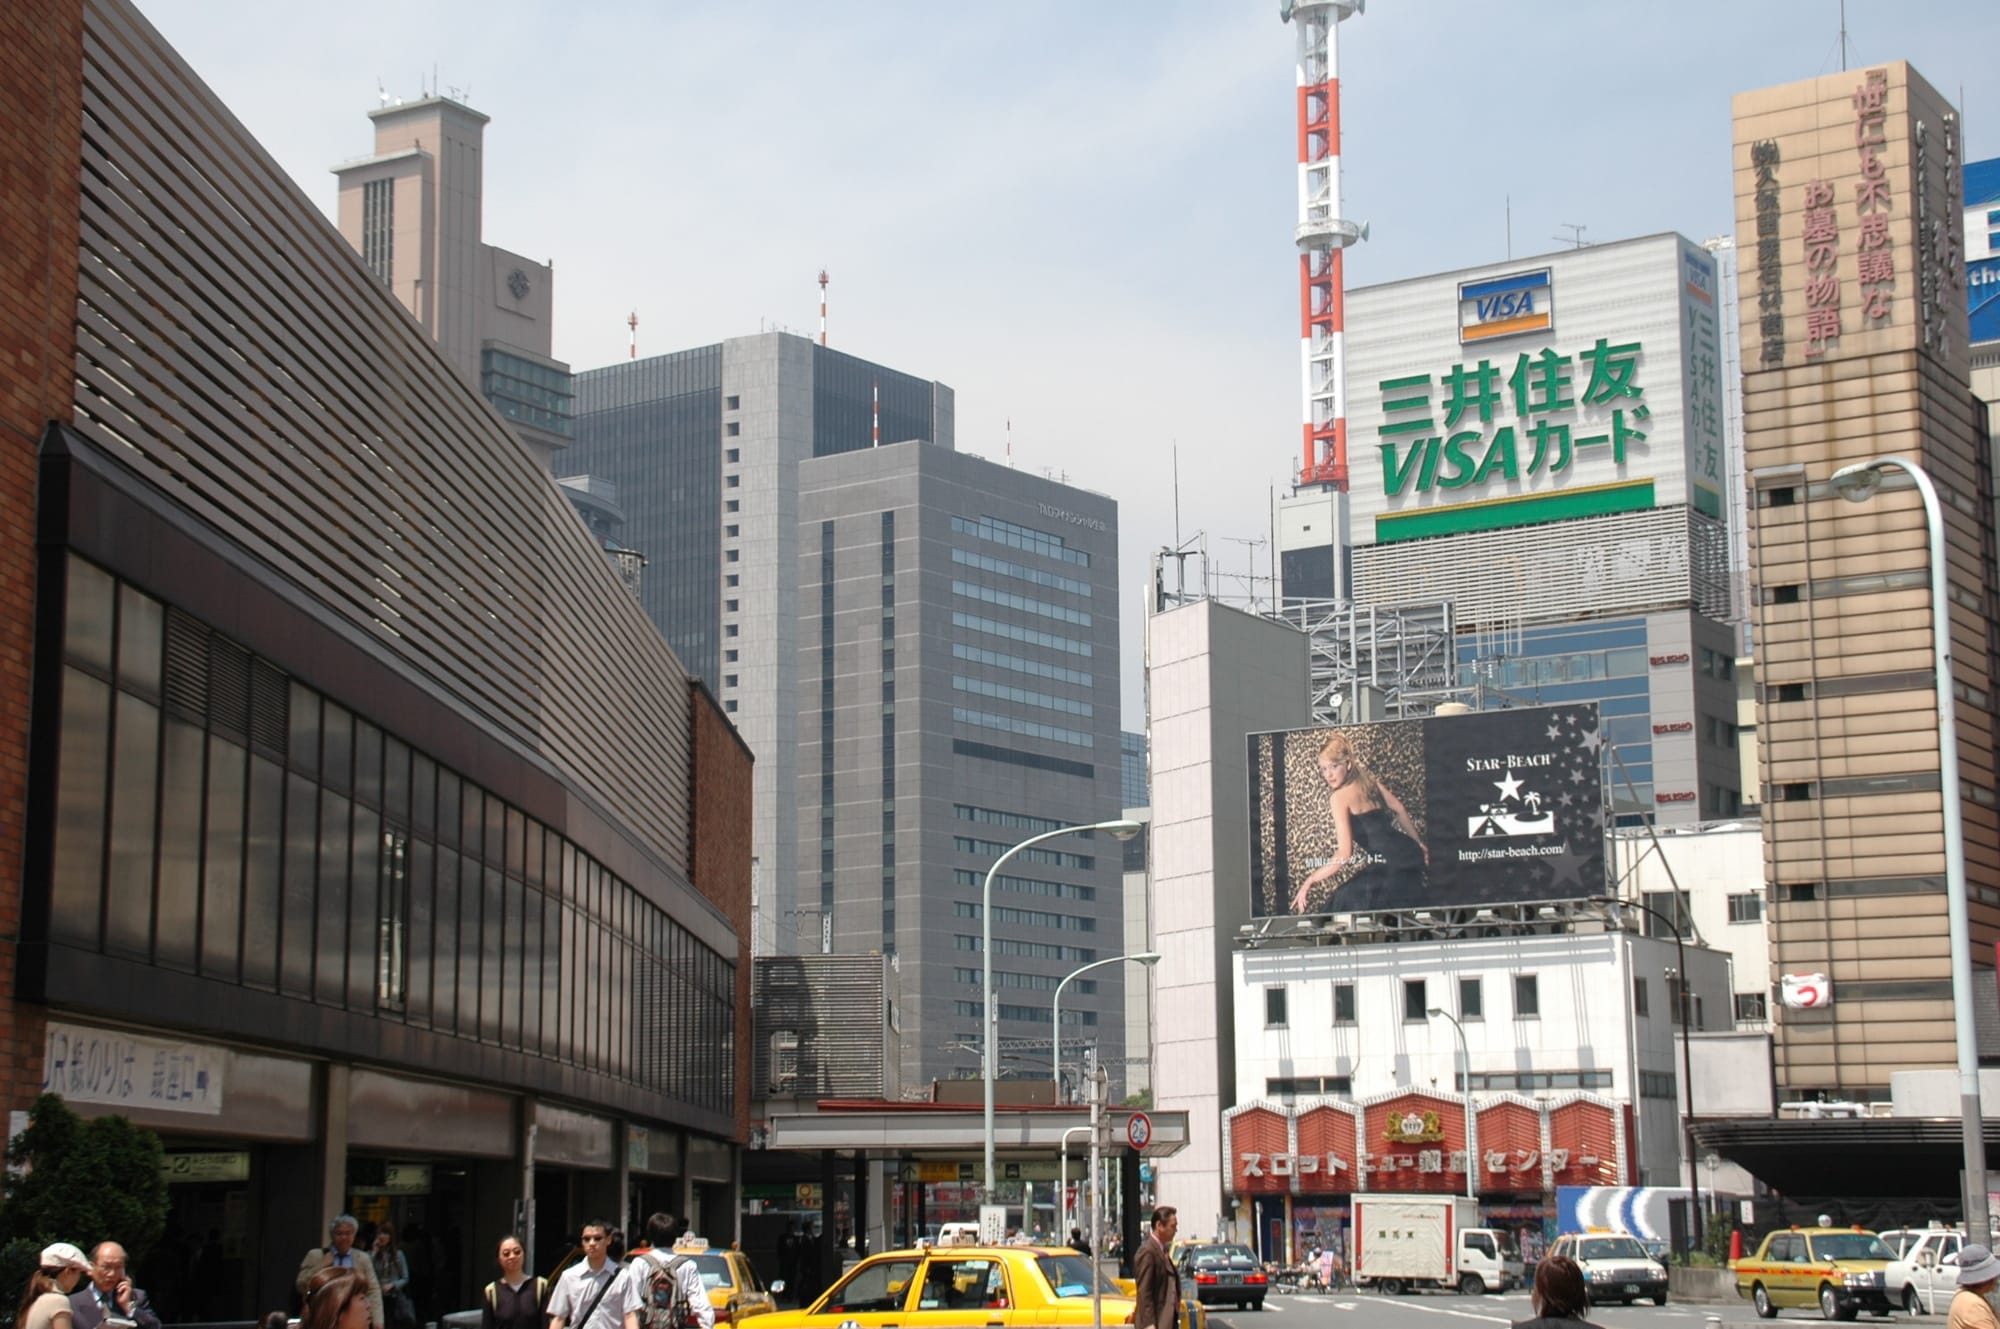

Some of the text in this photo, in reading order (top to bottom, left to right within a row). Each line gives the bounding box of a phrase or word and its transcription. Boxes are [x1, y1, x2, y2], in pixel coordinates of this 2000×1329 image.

[1476, 289, 1534, 321] VISA
[1378, 338, 1644, 436] 三井住友
[1376, 404, 1650, 496] VISAカード
[1458, 842, 1566, 863] http://star-beach.com/
[1240, 1151, 1348, 1177] スロット
